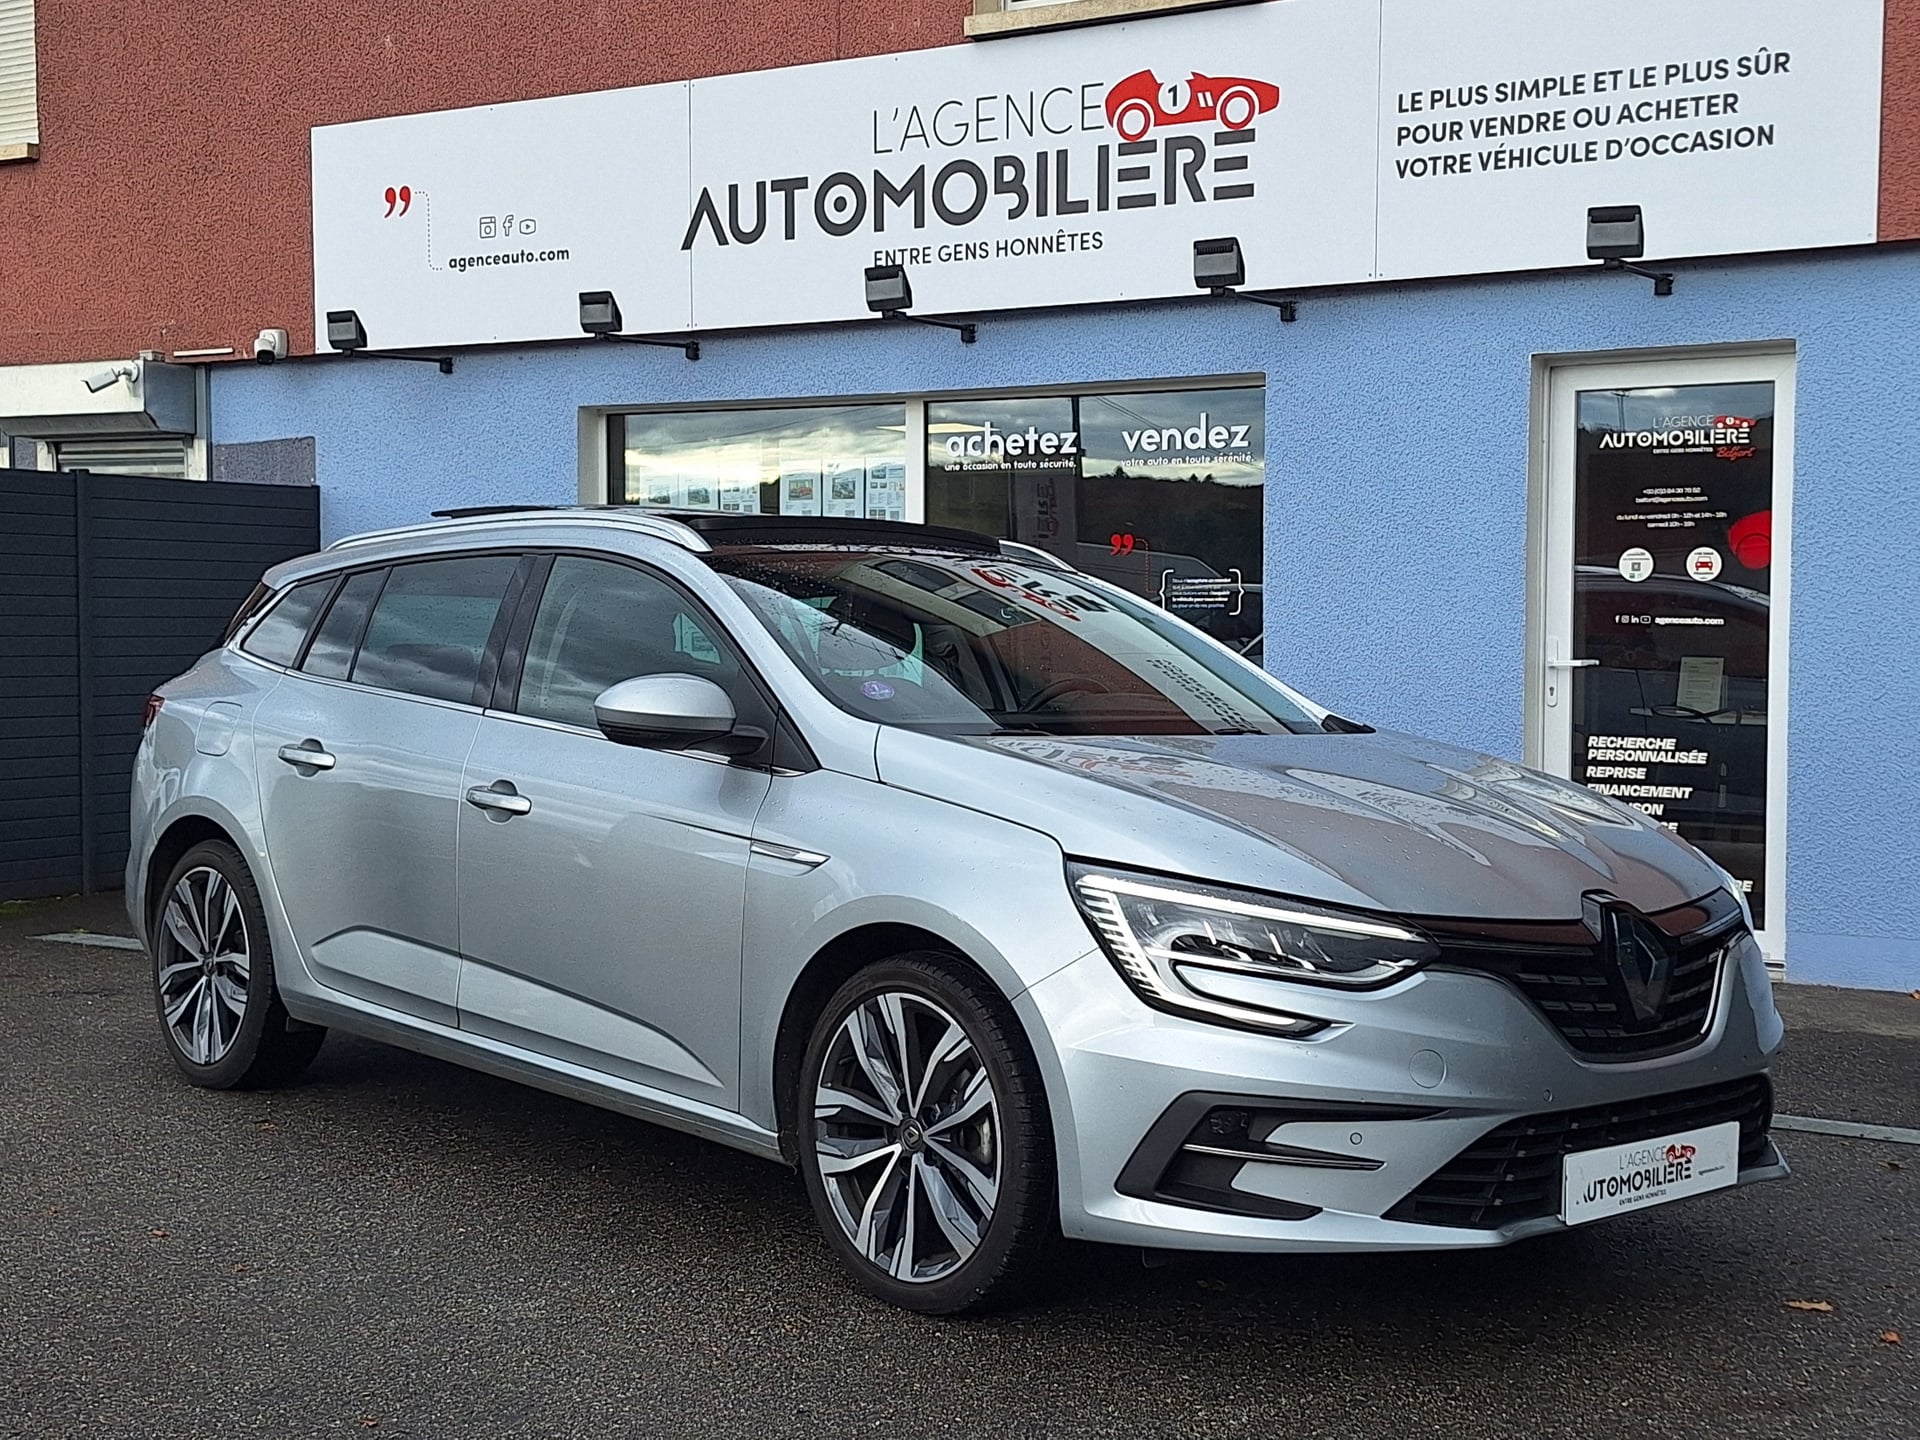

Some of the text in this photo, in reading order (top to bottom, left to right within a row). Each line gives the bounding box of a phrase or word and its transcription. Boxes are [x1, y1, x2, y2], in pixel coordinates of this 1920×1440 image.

[1397, 46, 1792, 114] LE PLUS SIMPLE ET LE PLUS SÛR
[1166, 84, 1178, 107] 1
[874, 82, 1105, 154] L'AGENCE
[1396, 93, 1740, 147] POUR VENDRE OU ACHETER
[1394, 124, 1776, 180] VOTRE VÉHICULE D'OCCASION
[448, 248, 570, 272] agenceauto.com
[874, 229, 1104, 267] ENTRE GENS HONNÊTES
[1121, 412, 1250, 453] vendez
[1653, 415, 1713, 429] L'AGENCE
[945, 421, 1078, 458] achetez
[944, 457, 1077, 472] une occasion en toute sécurité.
[1121, 452, 1255, 468] votre auto en toute sérénité.
[1587, 736, 1677, 749] RECHERCHE
[1587, 749, 1708, 764] PERSONNALISÉE
[1586, 766, 1647, 779] REPRISE
[1587, 783, 1693, 799] FINANCEMENT
[1619, 1145, 1667, 1170] L'AGENCE
